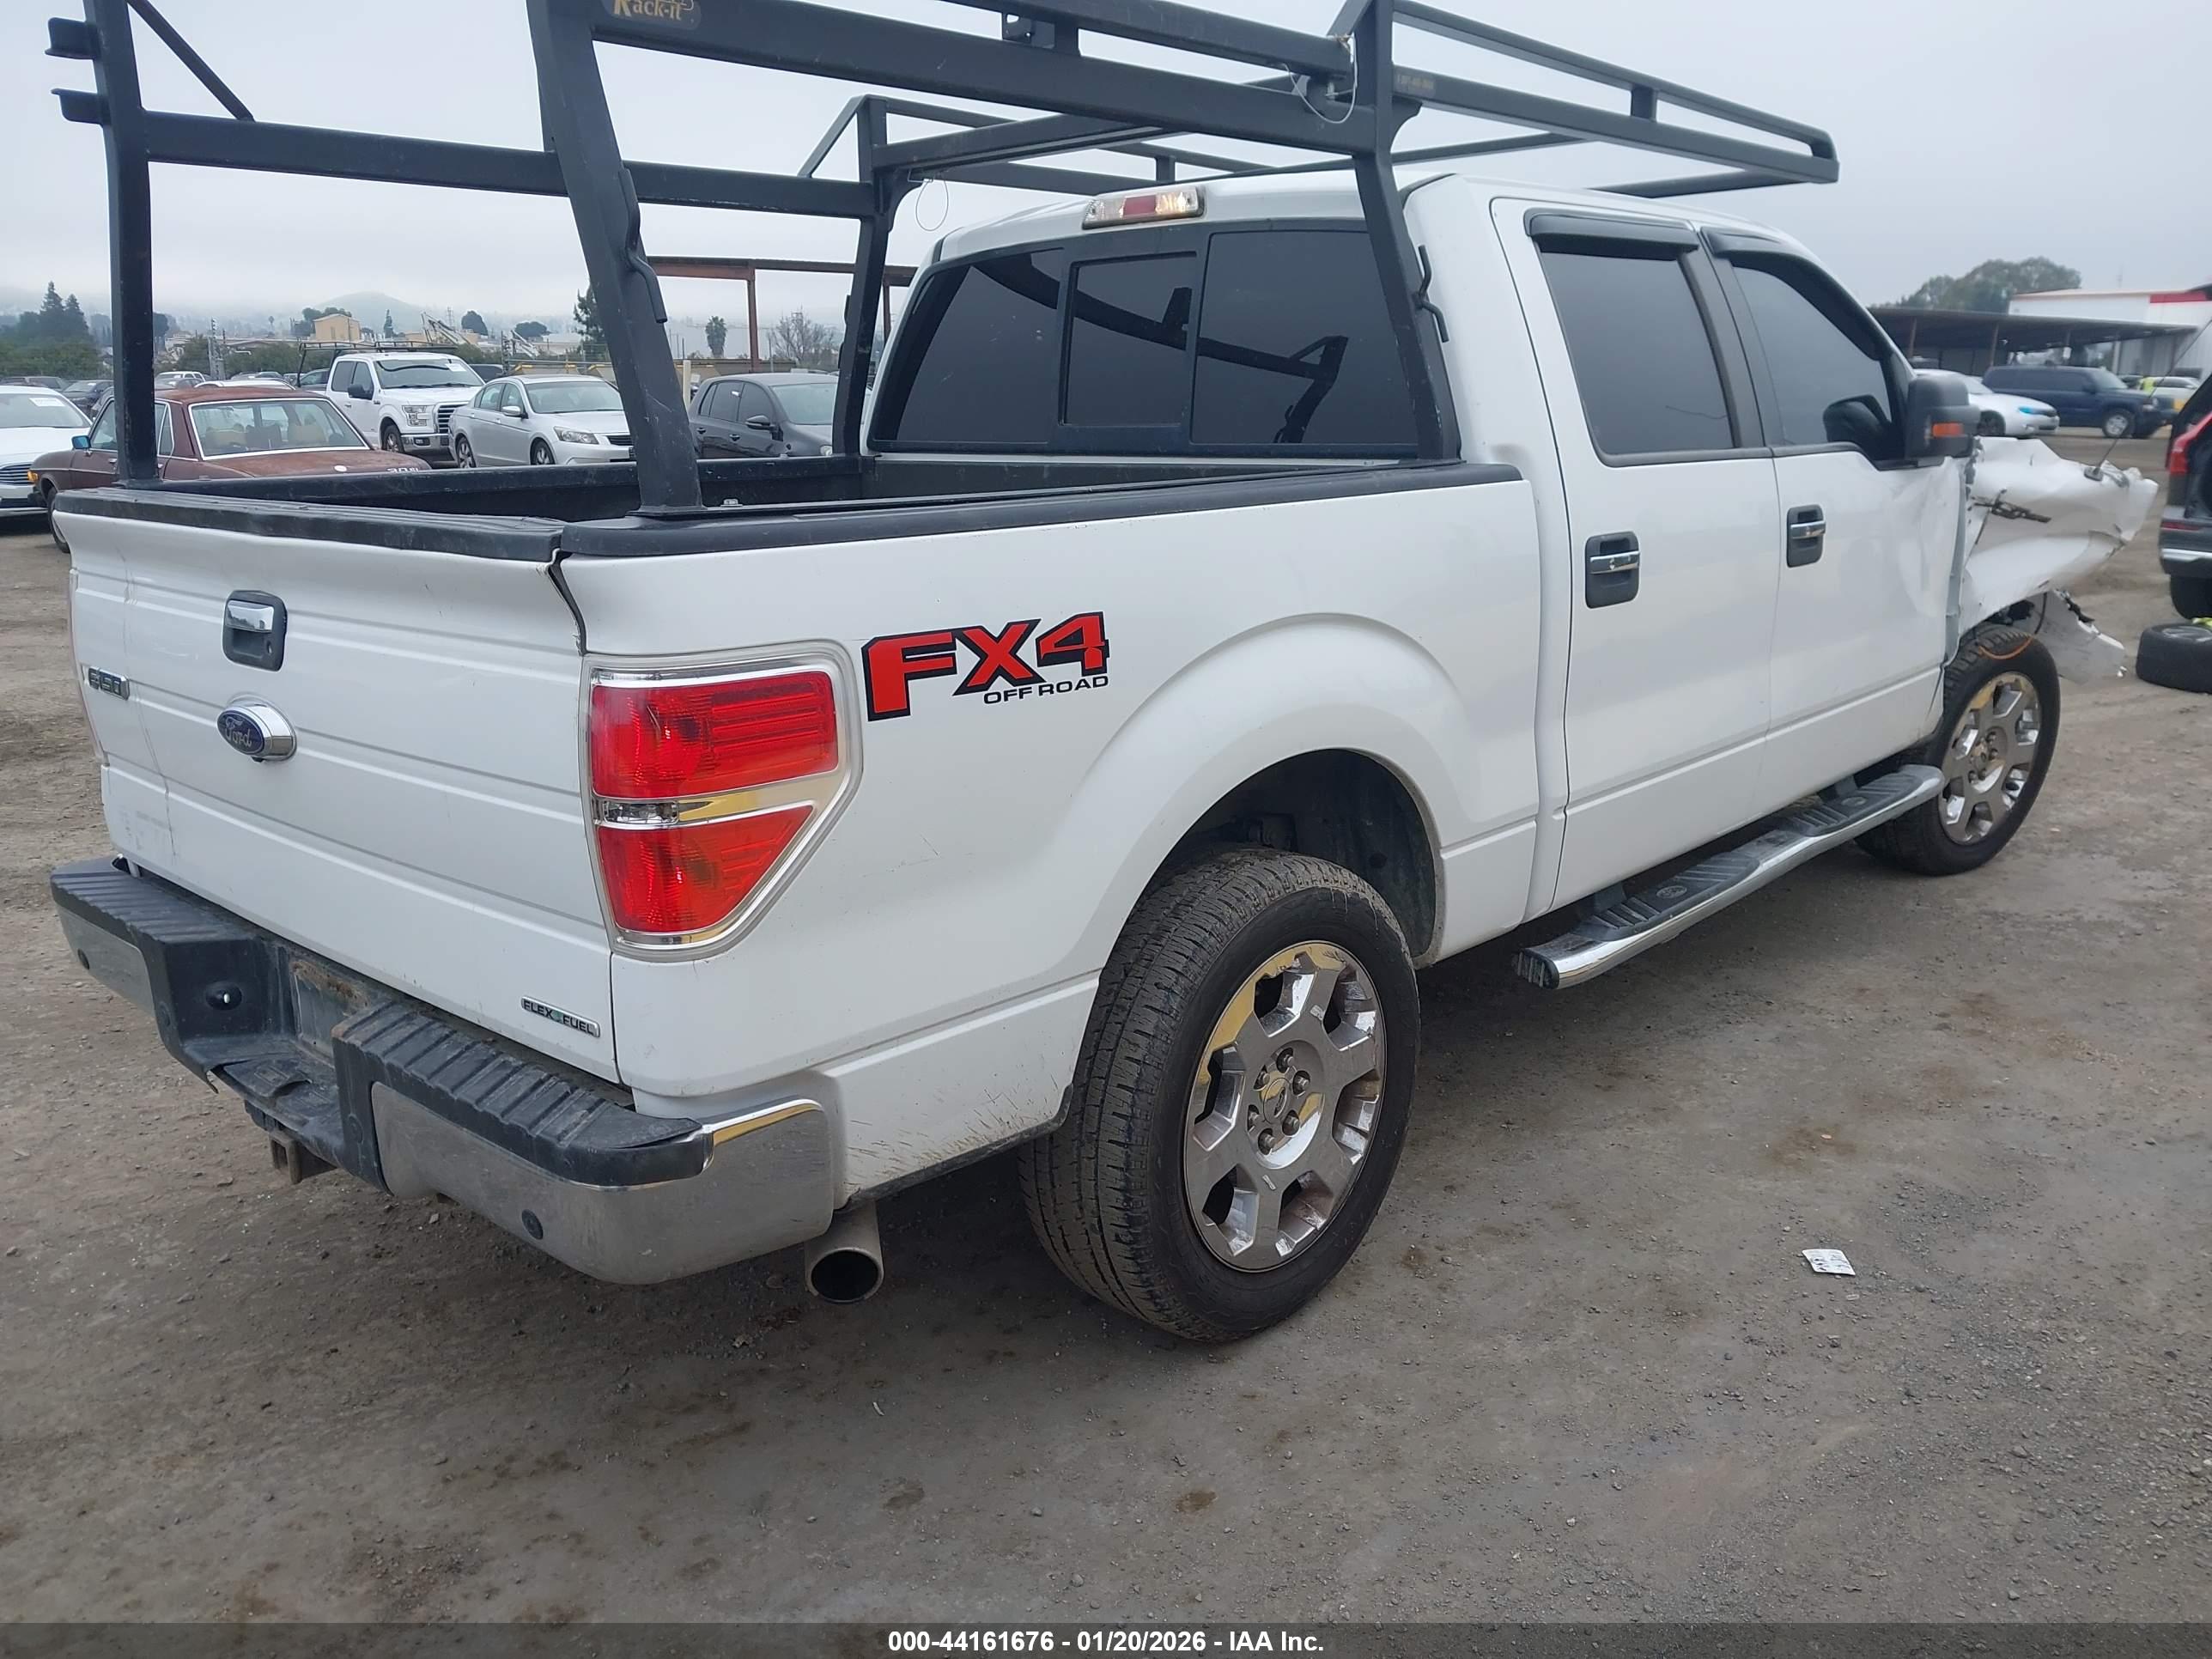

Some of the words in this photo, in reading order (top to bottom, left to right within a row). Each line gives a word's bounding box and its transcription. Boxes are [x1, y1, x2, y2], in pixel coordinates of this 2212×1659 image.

[861, 611, 1109, 721] FX4
[983, 686, 1033, 704] OFF
[1037, 675, 1109, 696] ROAD
[224, 716, 252, 748] Ford
[523, 999, 554, 1022] FLEX
[562, 1014, 596, 1036] FUEL
